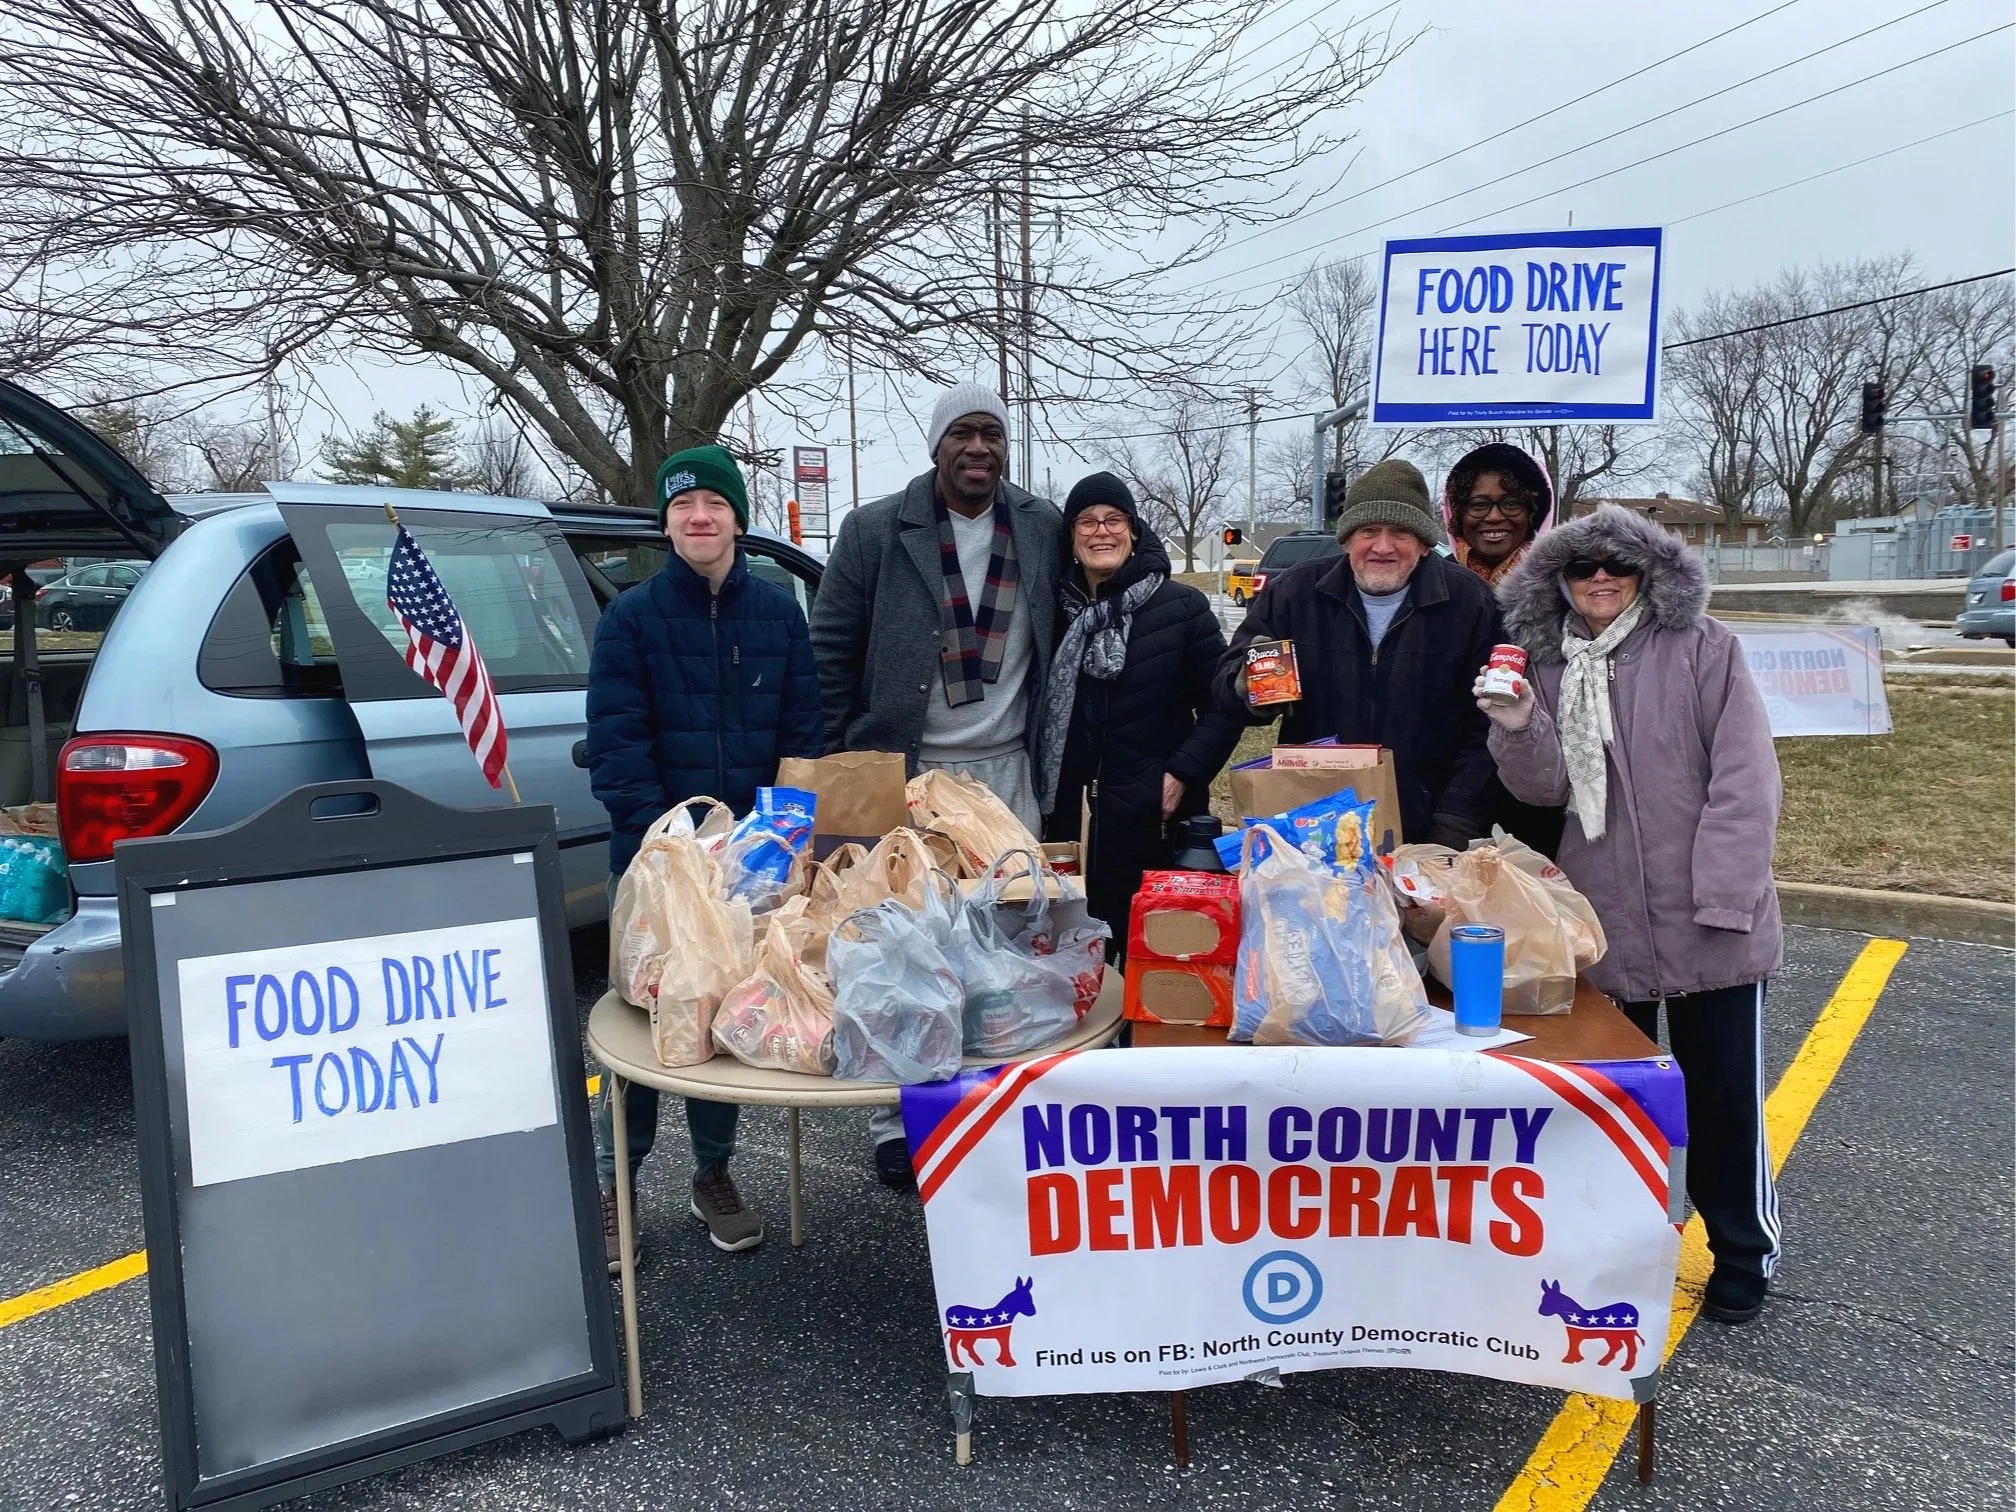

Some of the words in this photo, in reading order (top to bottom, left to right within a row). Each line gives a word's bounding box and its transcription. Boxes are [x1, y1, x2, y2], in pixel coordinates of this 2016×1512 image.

[1416, 265, 1514, 316] FOOD
[1526, 261, 1626, 313] DRIVE
[1417, 325, 1502, 376] HERE
[1521, 322, 1611, 376] TODAY
[1277, 759, 1308, 768] Millville
[225, 966, 360, 1048] FOOD
[382, 949, 508, 1026] DRIVE
[270, 1033, 444, 1124] TODAY
[1022, 1103, 1248, 1172] NORTH
[1268, 1106, 1554, 1165] COUNTY
[1026, 1163, 1546, 1258] DEMOCRATS
[1266, 1271, 1302, 1305] D
[1036, 1348, 1084, 1367] Find
[1091, 1350, 1117, 1364] us
[1124, 1349, 1151, 1363] on
[1158, 1343, 1195, 1362] FB:
[1203, 1334, 1260, 1358] North
[1268, 1328, 1344, 1347] County
[1351, 1325, 1479, 1348] Democratic
[1486, 1336, 1540, 1361] Club
